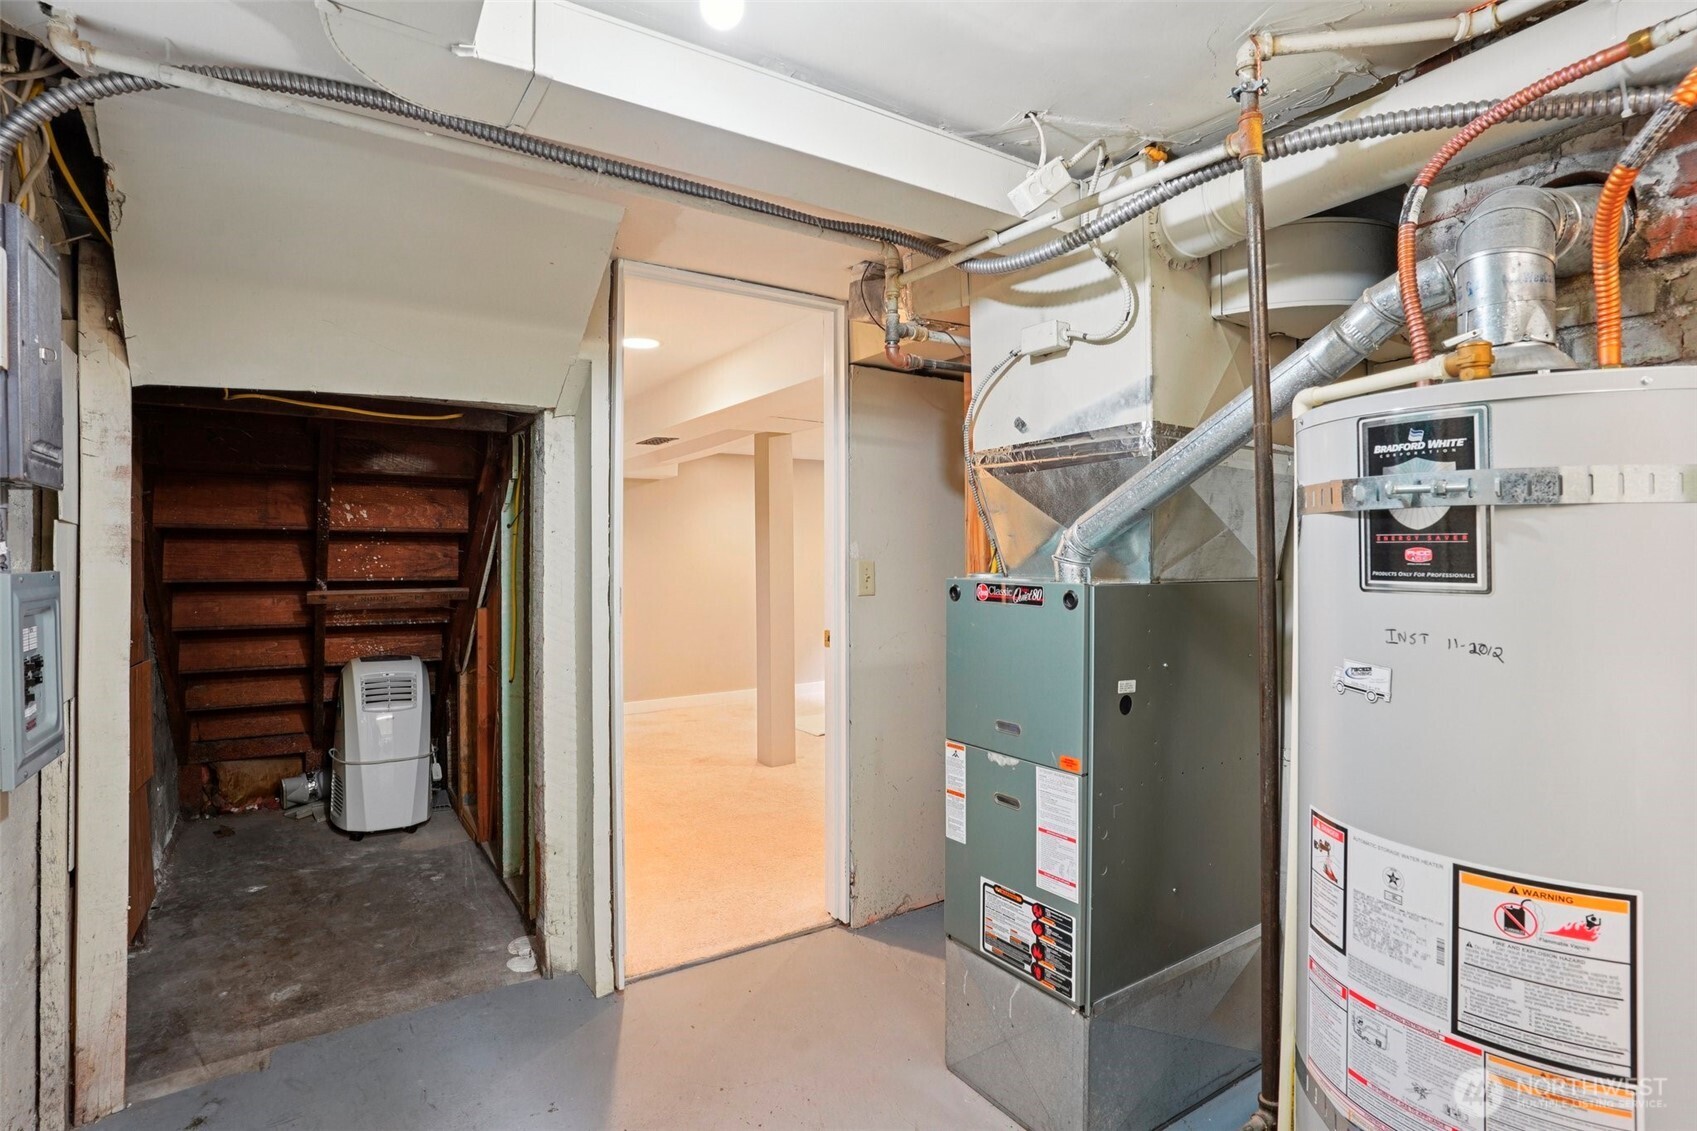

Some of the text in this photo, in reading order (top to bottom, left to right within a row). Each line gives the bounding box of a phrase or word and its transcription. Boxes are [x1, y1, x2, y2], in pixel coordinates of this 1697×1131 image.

[1373, 438, 1465, 454] BRADFORD WHITE
[1379, 448, 1457, 459] CORPORATION
[988, 585, 1013, 597] Classic
[1385, 628, 1504, 664] INST 11-2012
[1401, 853, 1420, 863] WATER
[1421, 859, 1444, 869] HEATER
[1522, 888, 1574, 905] WARNING
